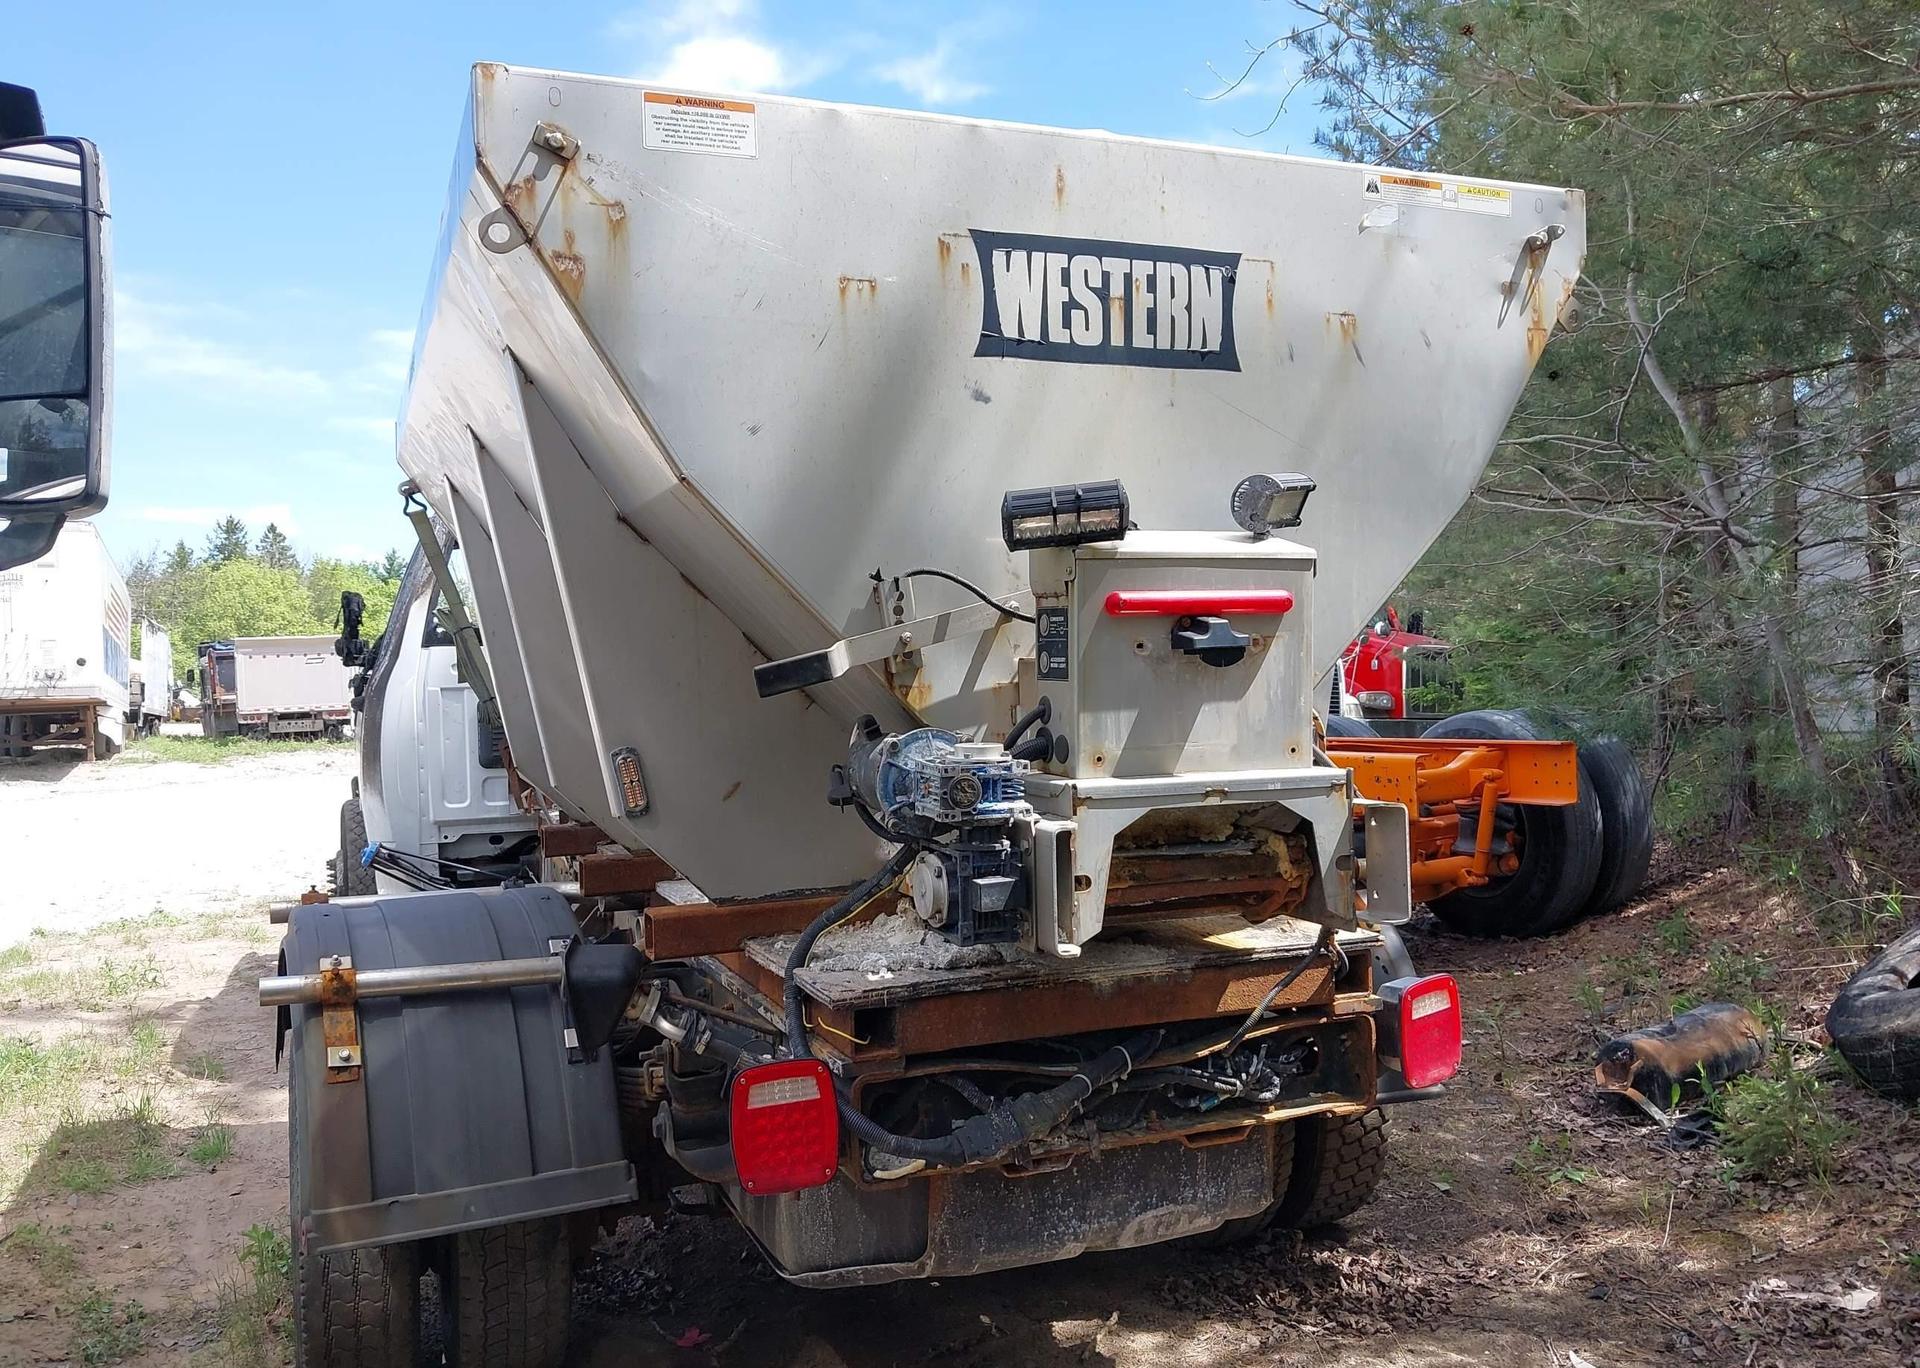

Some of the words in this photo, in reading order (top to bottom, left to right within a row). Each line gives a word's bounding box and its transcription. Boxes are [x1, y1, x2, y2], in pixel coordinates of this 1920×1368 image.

[685, 98, 725, 109] WARNING
[1398, 177, 1430, 188] WARNING
[1472, 187, 1500, 196] CAUTION
[992, 248, 1224, 352] WESTERN
